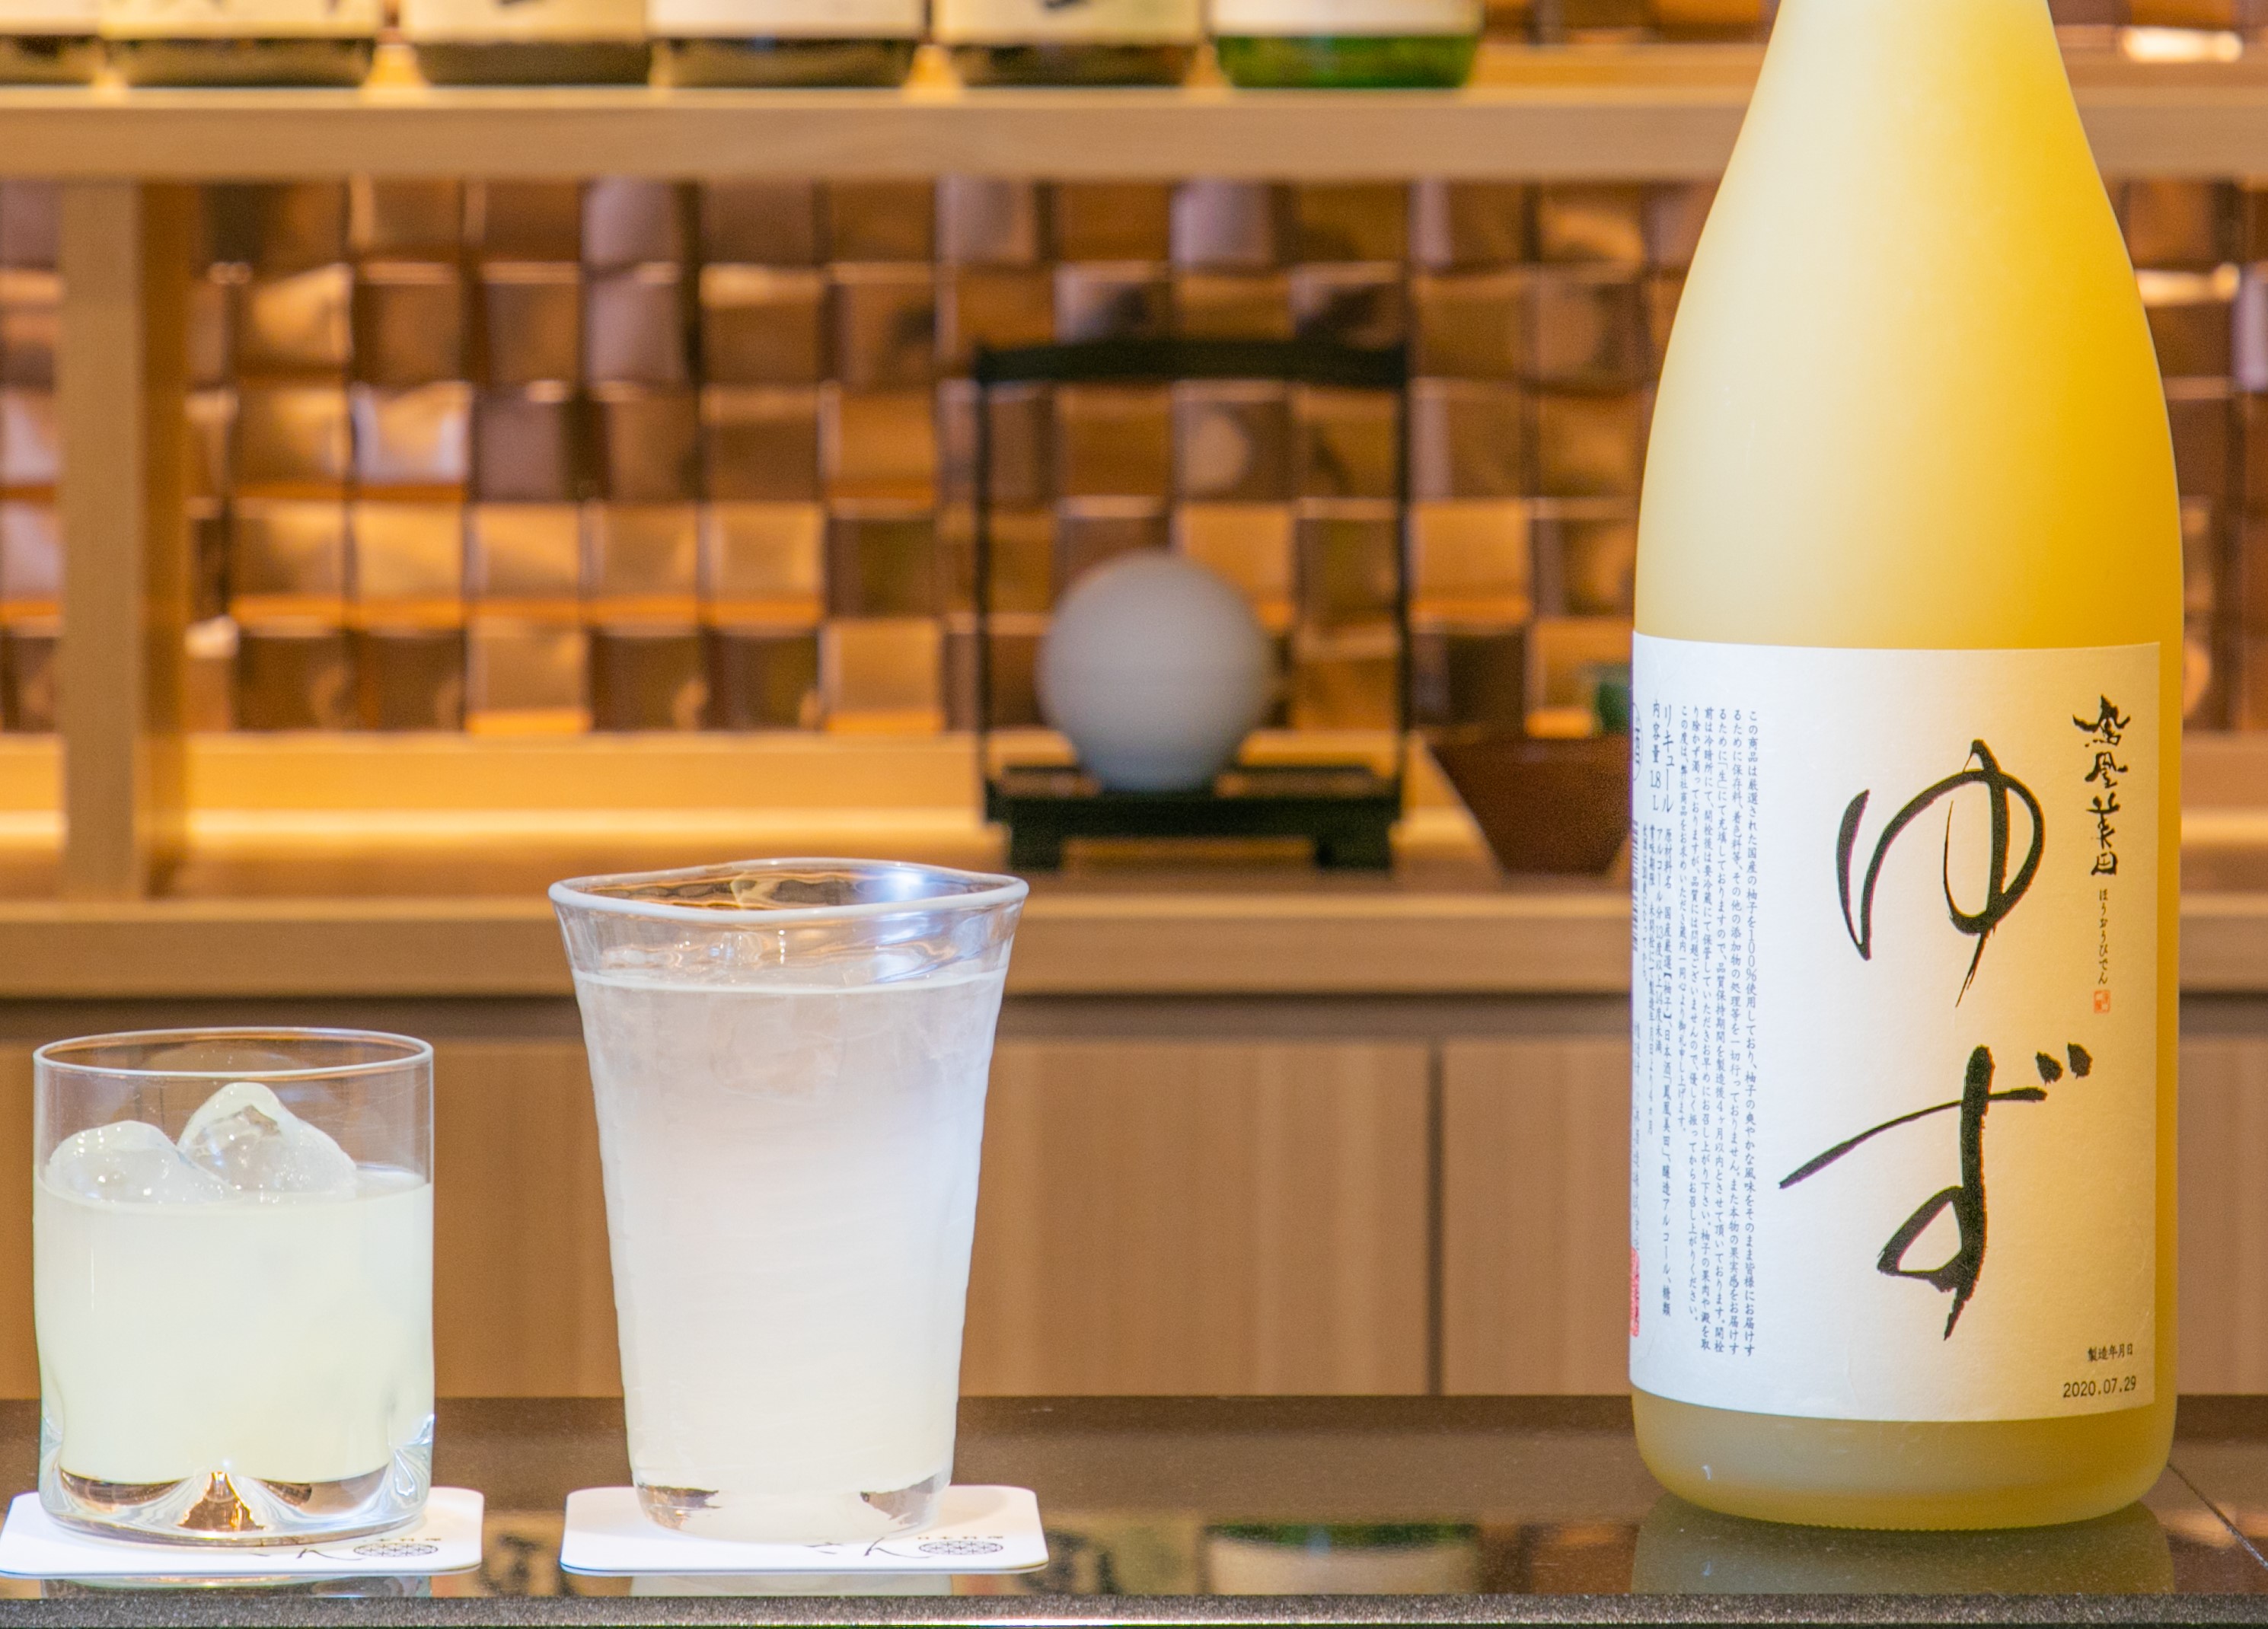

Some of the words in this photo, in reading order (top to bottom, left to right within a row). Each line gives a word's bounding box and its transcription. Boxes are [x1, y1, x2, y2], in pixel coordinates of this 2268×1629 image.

[1663, 704, 1675, 812] リキュール
[1780, 738, 2092, 1340] ゆず
[2088, 1343, 2132, 1361] 製造年月日
[2063, 1375, 2136, 1398] 2020.07.29
